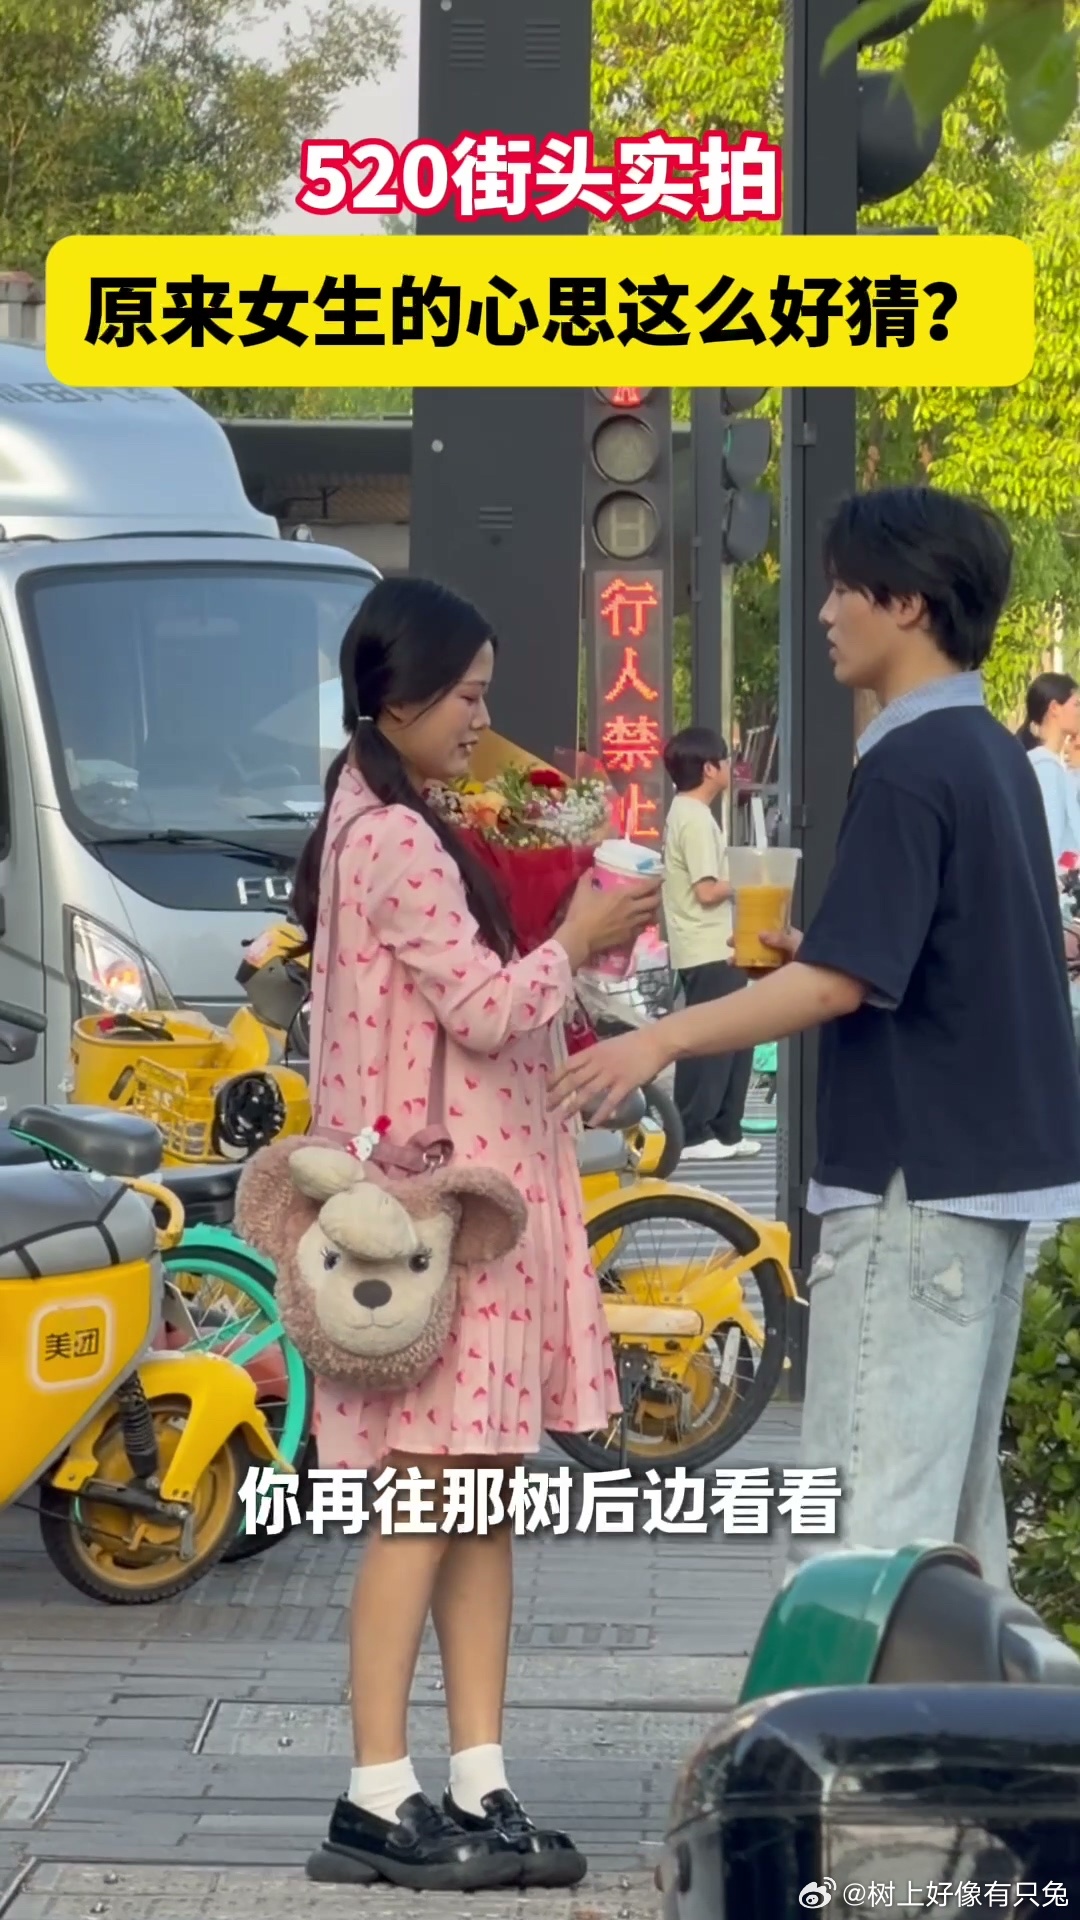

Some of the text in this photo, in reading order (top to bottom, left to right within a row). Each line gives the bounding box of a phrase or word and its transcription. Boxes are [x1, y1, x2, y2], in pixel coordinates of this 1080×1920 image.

[599, 578, 661, 840] 行人禁止
[44, 1327, 100, 1361] 美团
